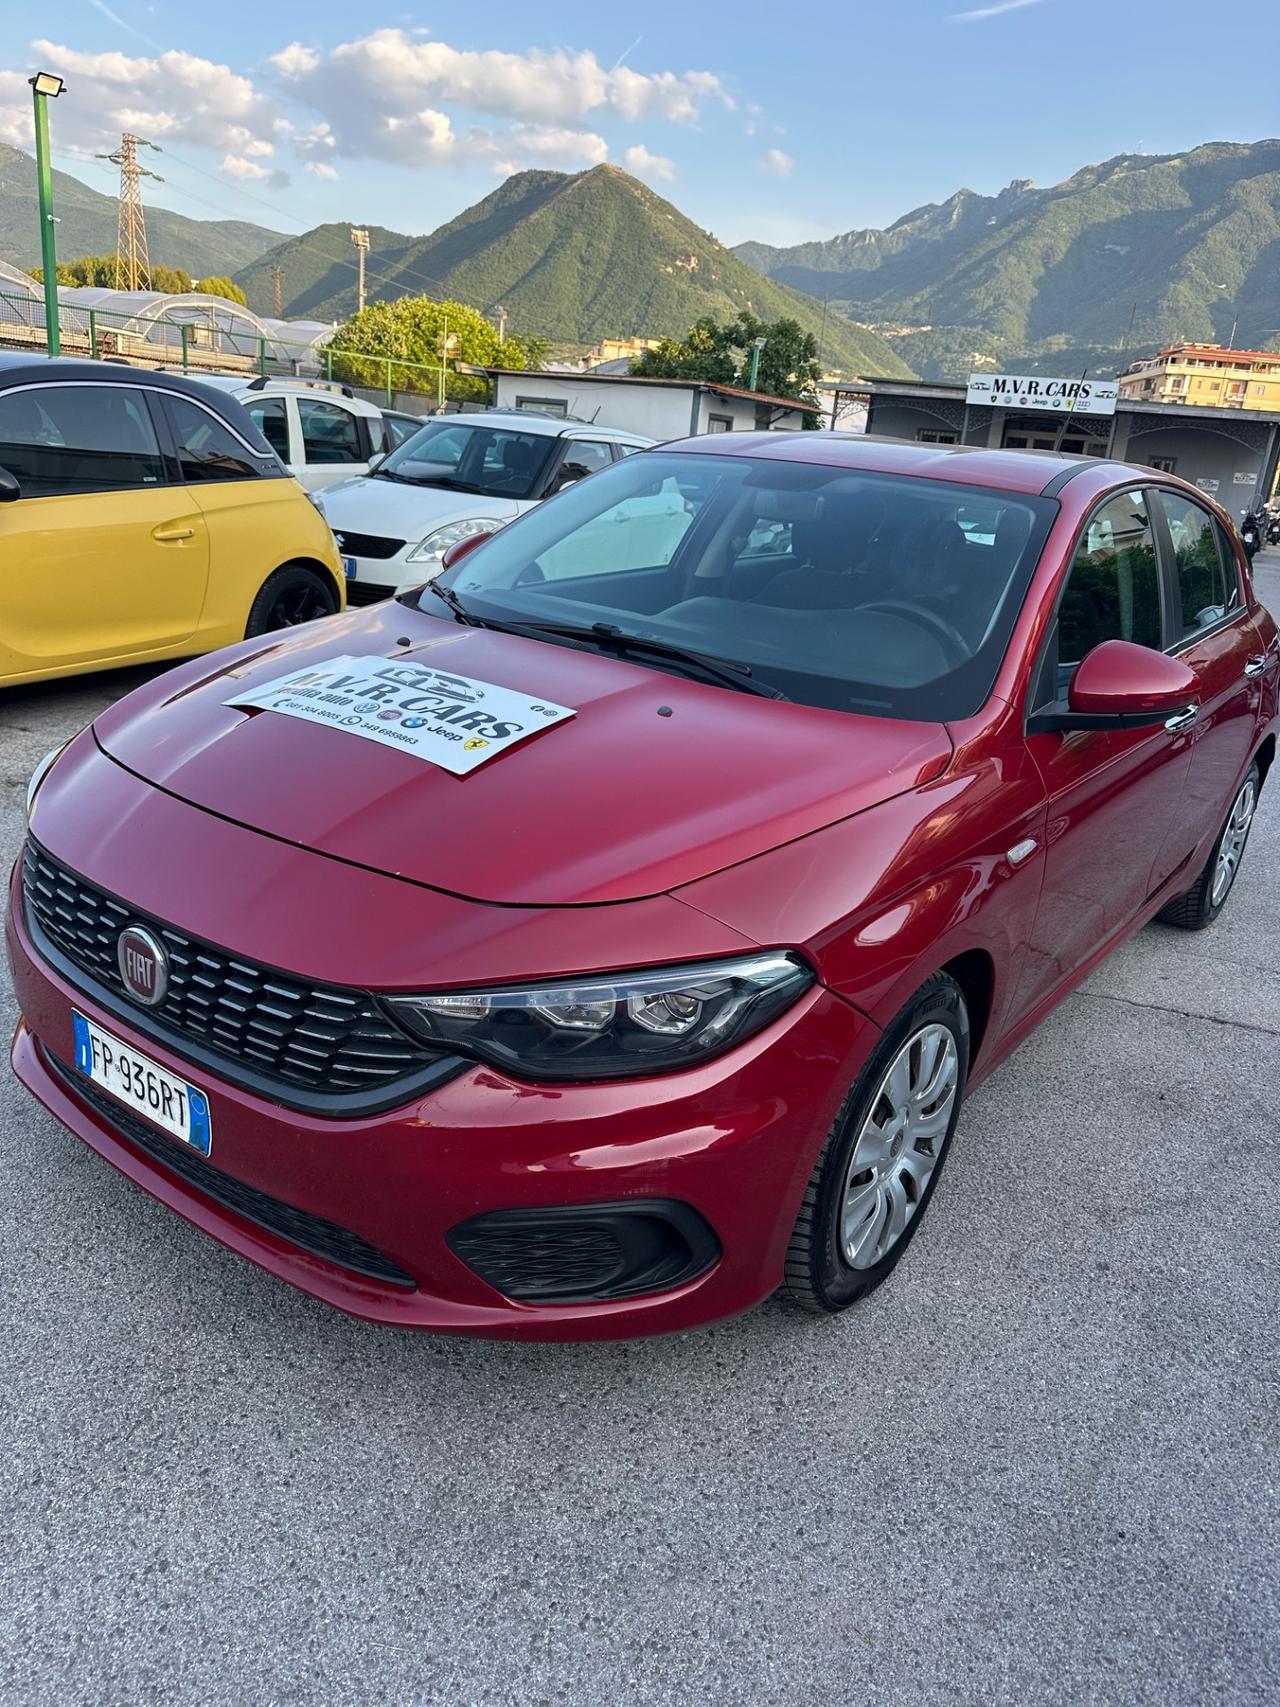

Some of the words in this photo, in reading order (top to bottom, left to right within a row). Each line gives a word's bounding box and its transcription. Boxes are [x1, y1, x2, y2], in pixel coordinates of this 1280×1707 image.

[317, 693, 353, 706] auto
[361, 722, 380, 732] 349
[426, 726, 464, 742] Jeep
[126, 948, 153, 989] FIAT
[90, 1033, 113, 1078] FP
[119, 1055, 186, 1127] 936RT
